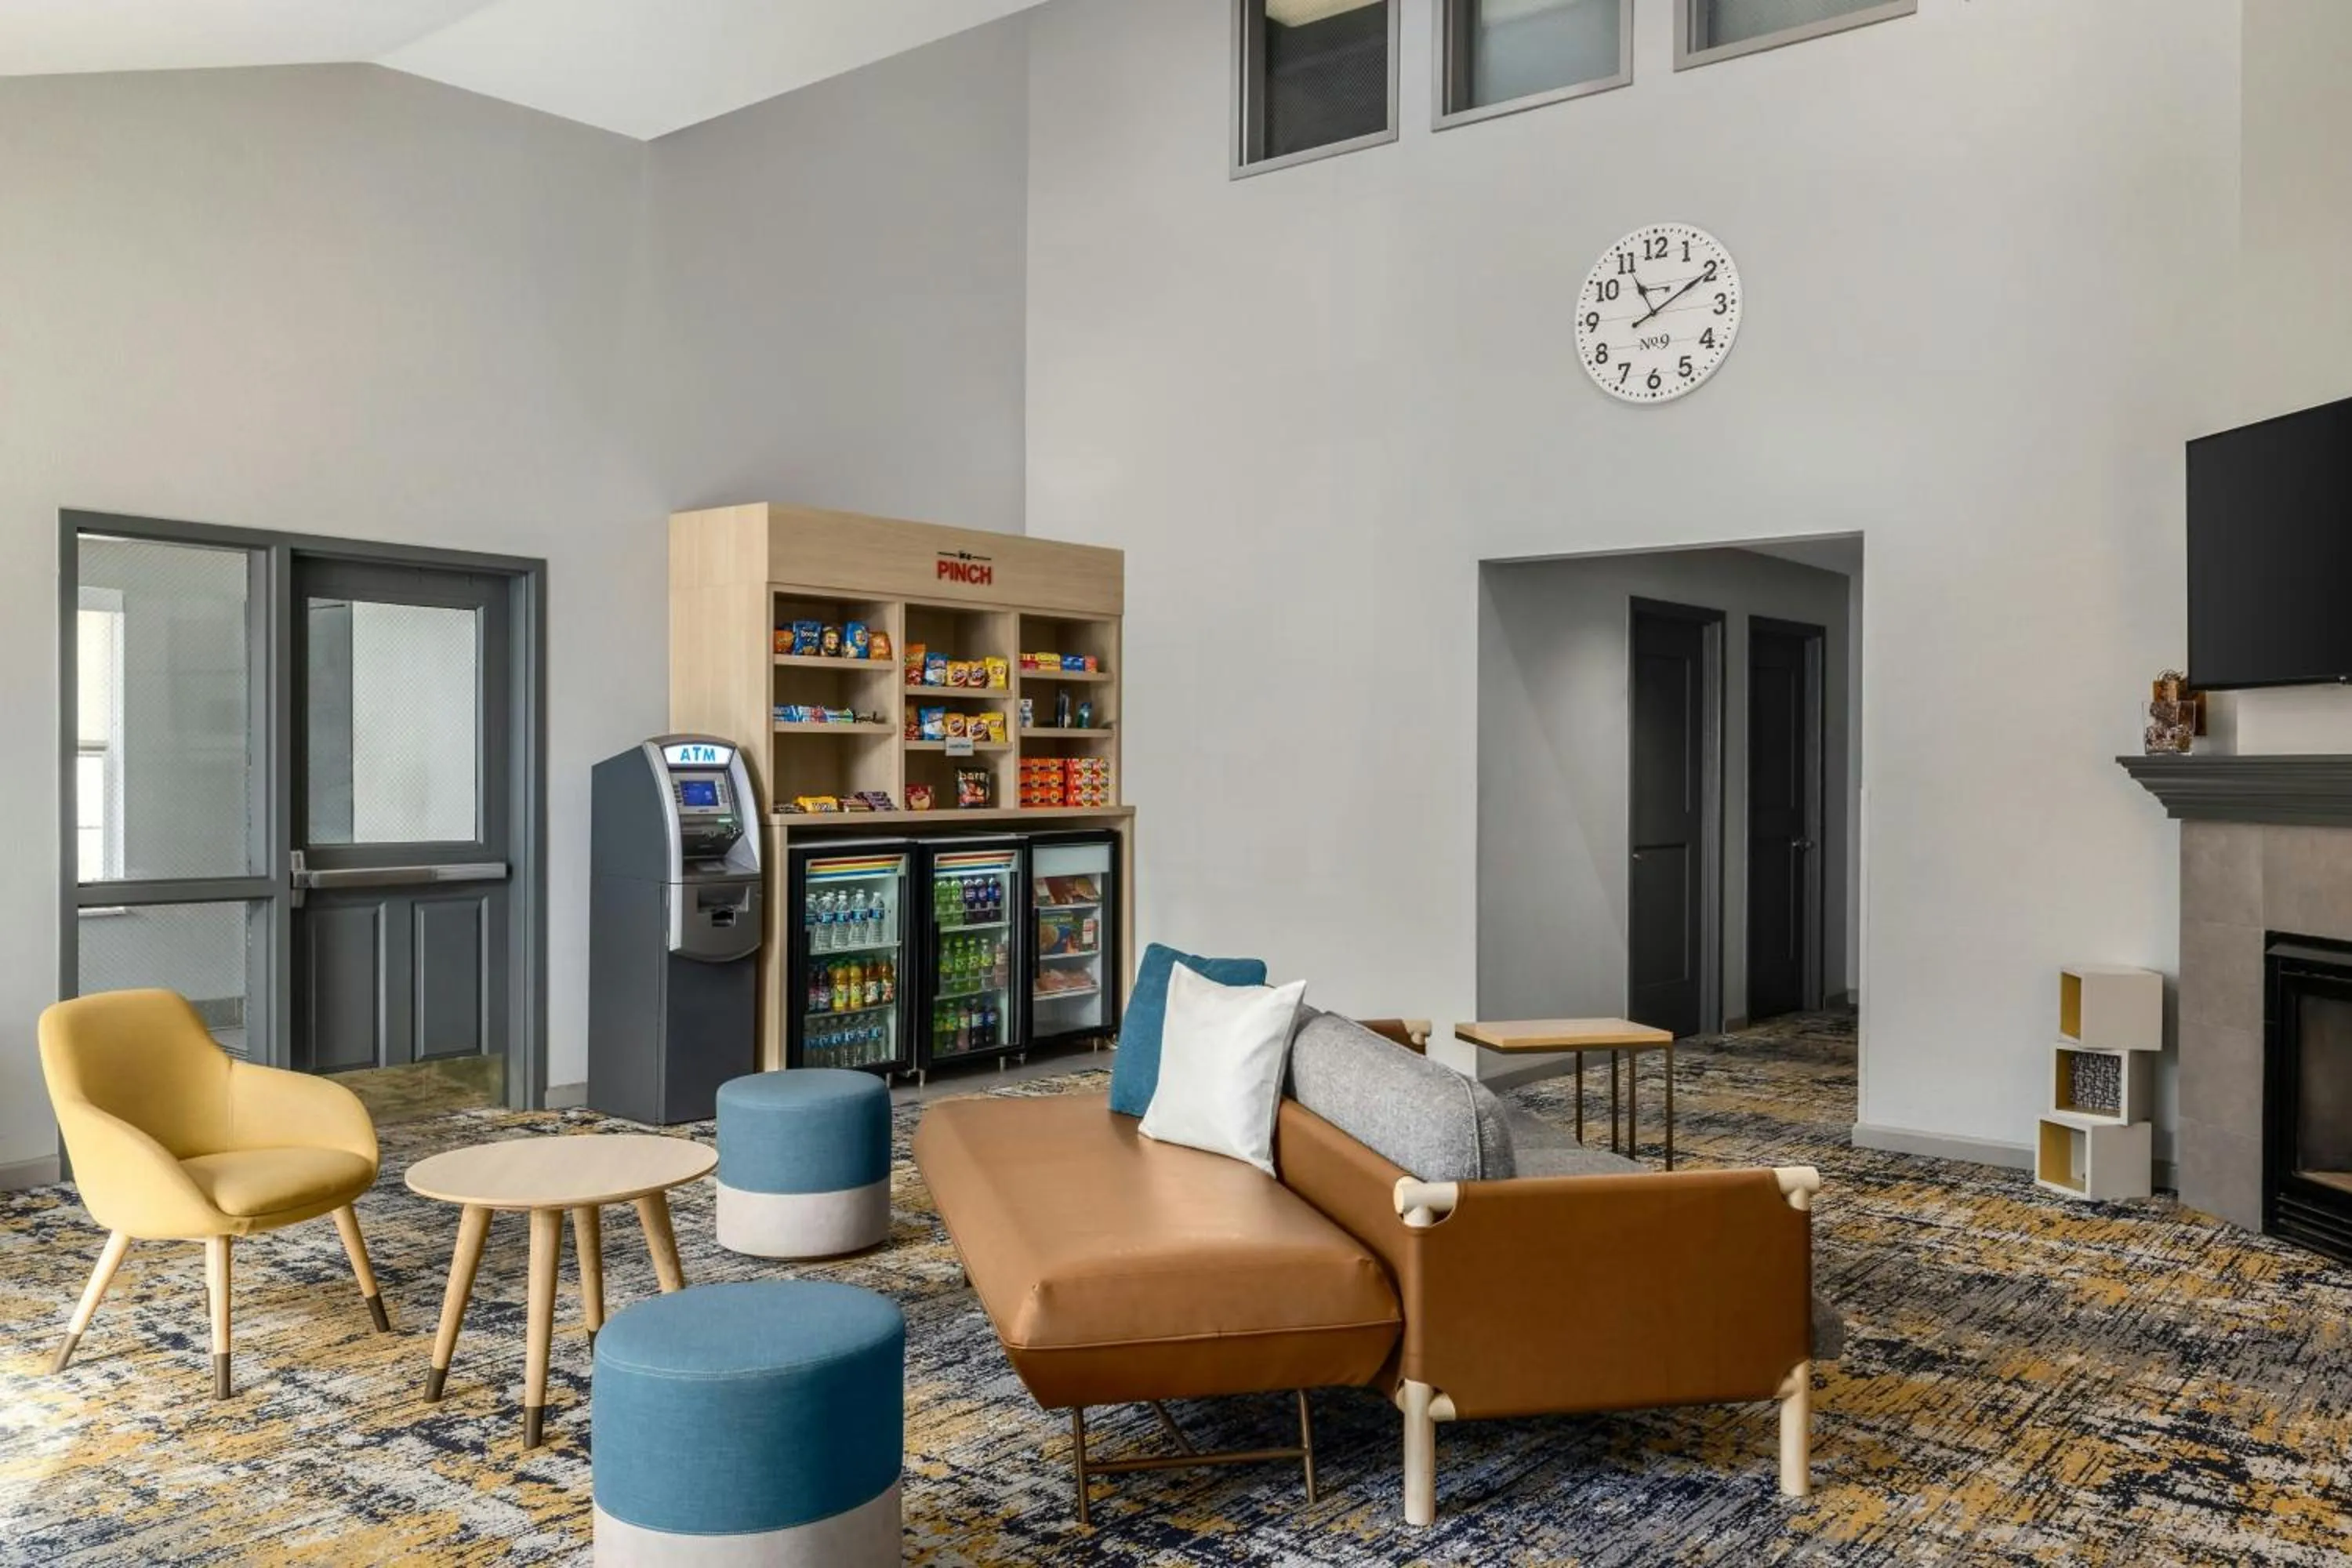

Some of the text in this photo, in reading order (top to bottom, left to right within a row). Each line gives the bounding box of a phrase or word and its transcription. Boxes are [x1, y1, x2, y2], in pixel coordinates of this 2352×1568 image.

[1643, 237, 1668, 261] 12
[1682, 241, 1691, 263] 1
[1617, 252, 1636, 274] 11
[1703, 260, 1718, 283] 2
[1595, 278, 1619, 303] 10
[1712, 292, 1727, 315] 3
[1585, 311, 1600, 333] 9
[1698, 327, 1715, 350] 4
[1595, 343, 1608, 365] 8
[1617, 362, 1632, 384] 7
[1678, 355, 1693, 378] 5
[1646, 368, 1661, 390] 6
[937, 560, 992, 586] PINCH
[680, 746, 716, 762] ATM
